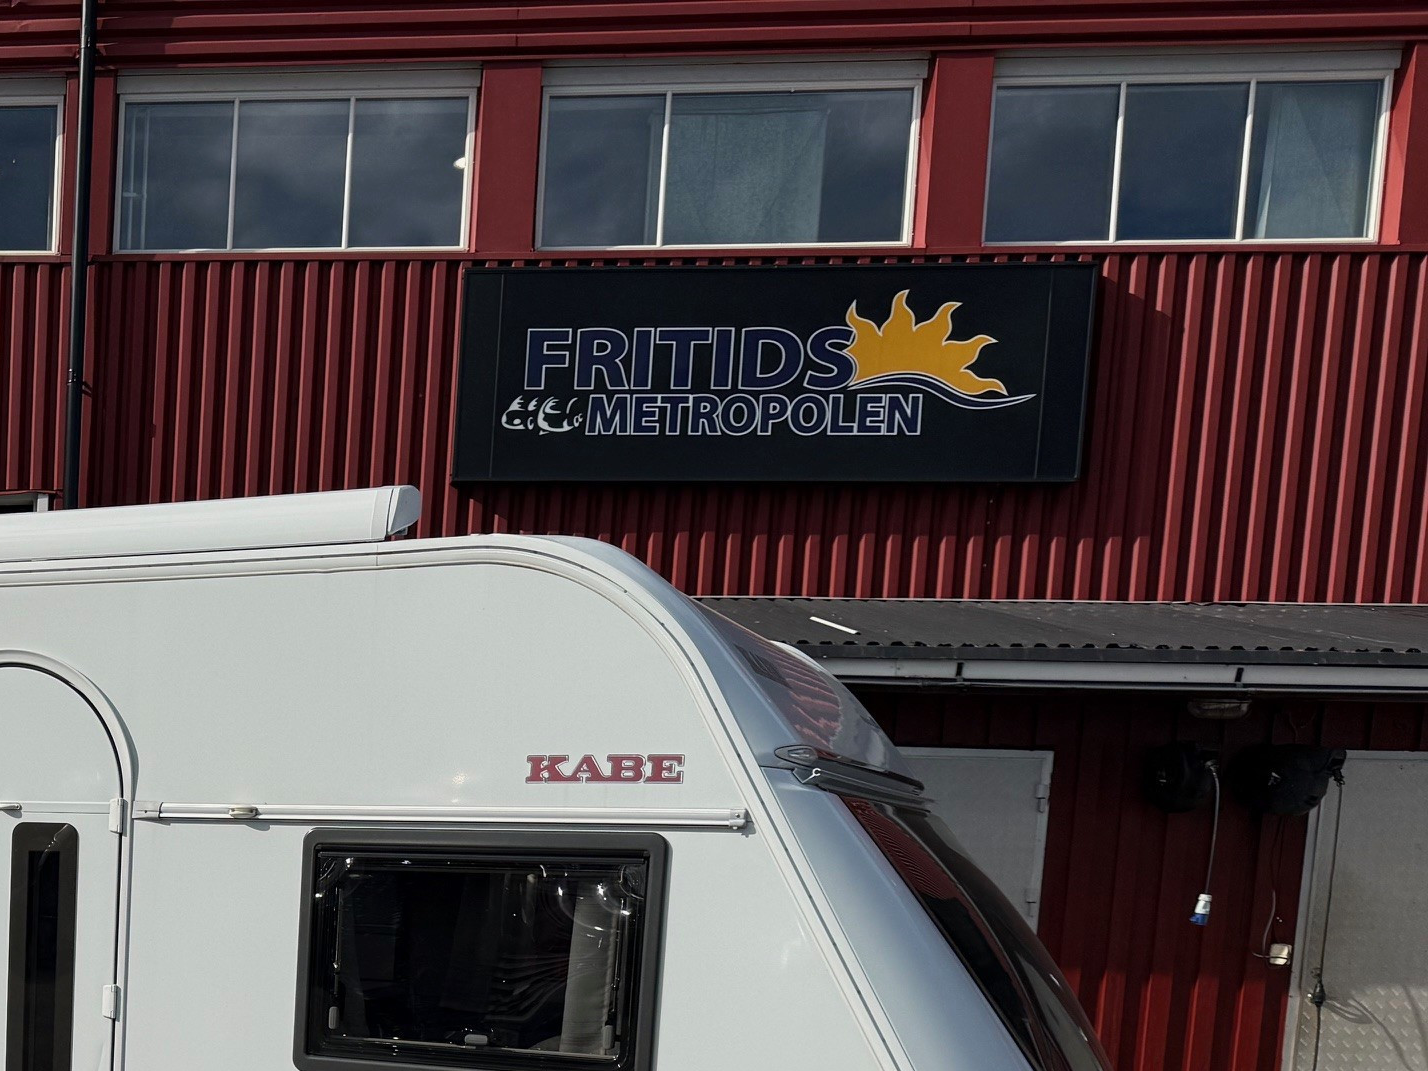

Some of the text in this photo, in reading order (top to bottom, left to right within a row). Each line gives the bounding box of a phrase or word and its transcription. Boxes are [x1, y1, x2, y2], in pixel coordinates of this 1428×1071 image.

[523, 326, 859, 390] FRITIDS
[584, 393, 923, 436] METROPOLEN
[525, 754, 685, 784] KABE
